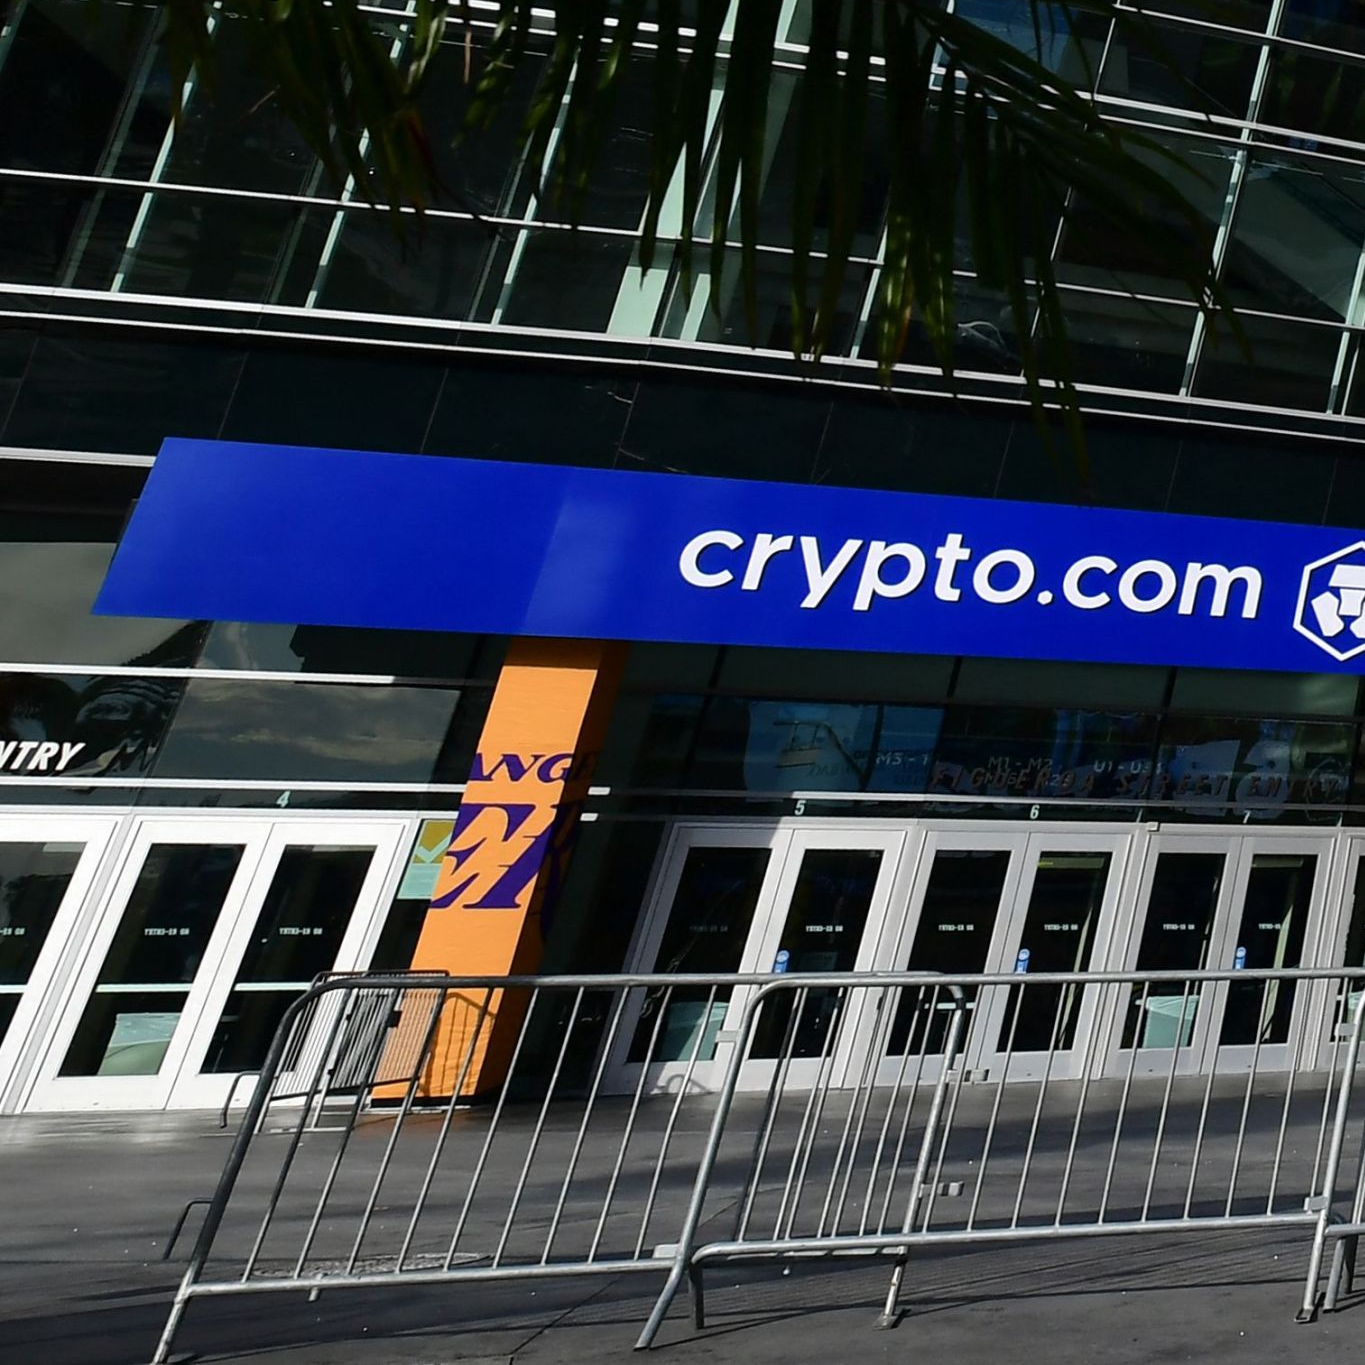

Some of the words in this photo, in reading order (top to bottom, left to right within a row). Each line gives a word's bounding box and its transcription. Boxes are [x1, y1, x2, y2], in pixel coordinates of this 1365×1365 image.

[679, 529, 1263, 620] crypto.com
[275, 790, 292, 808] 4
[794, 798, 807, 816] 5
[1029, 804, 1040, 820] 6
